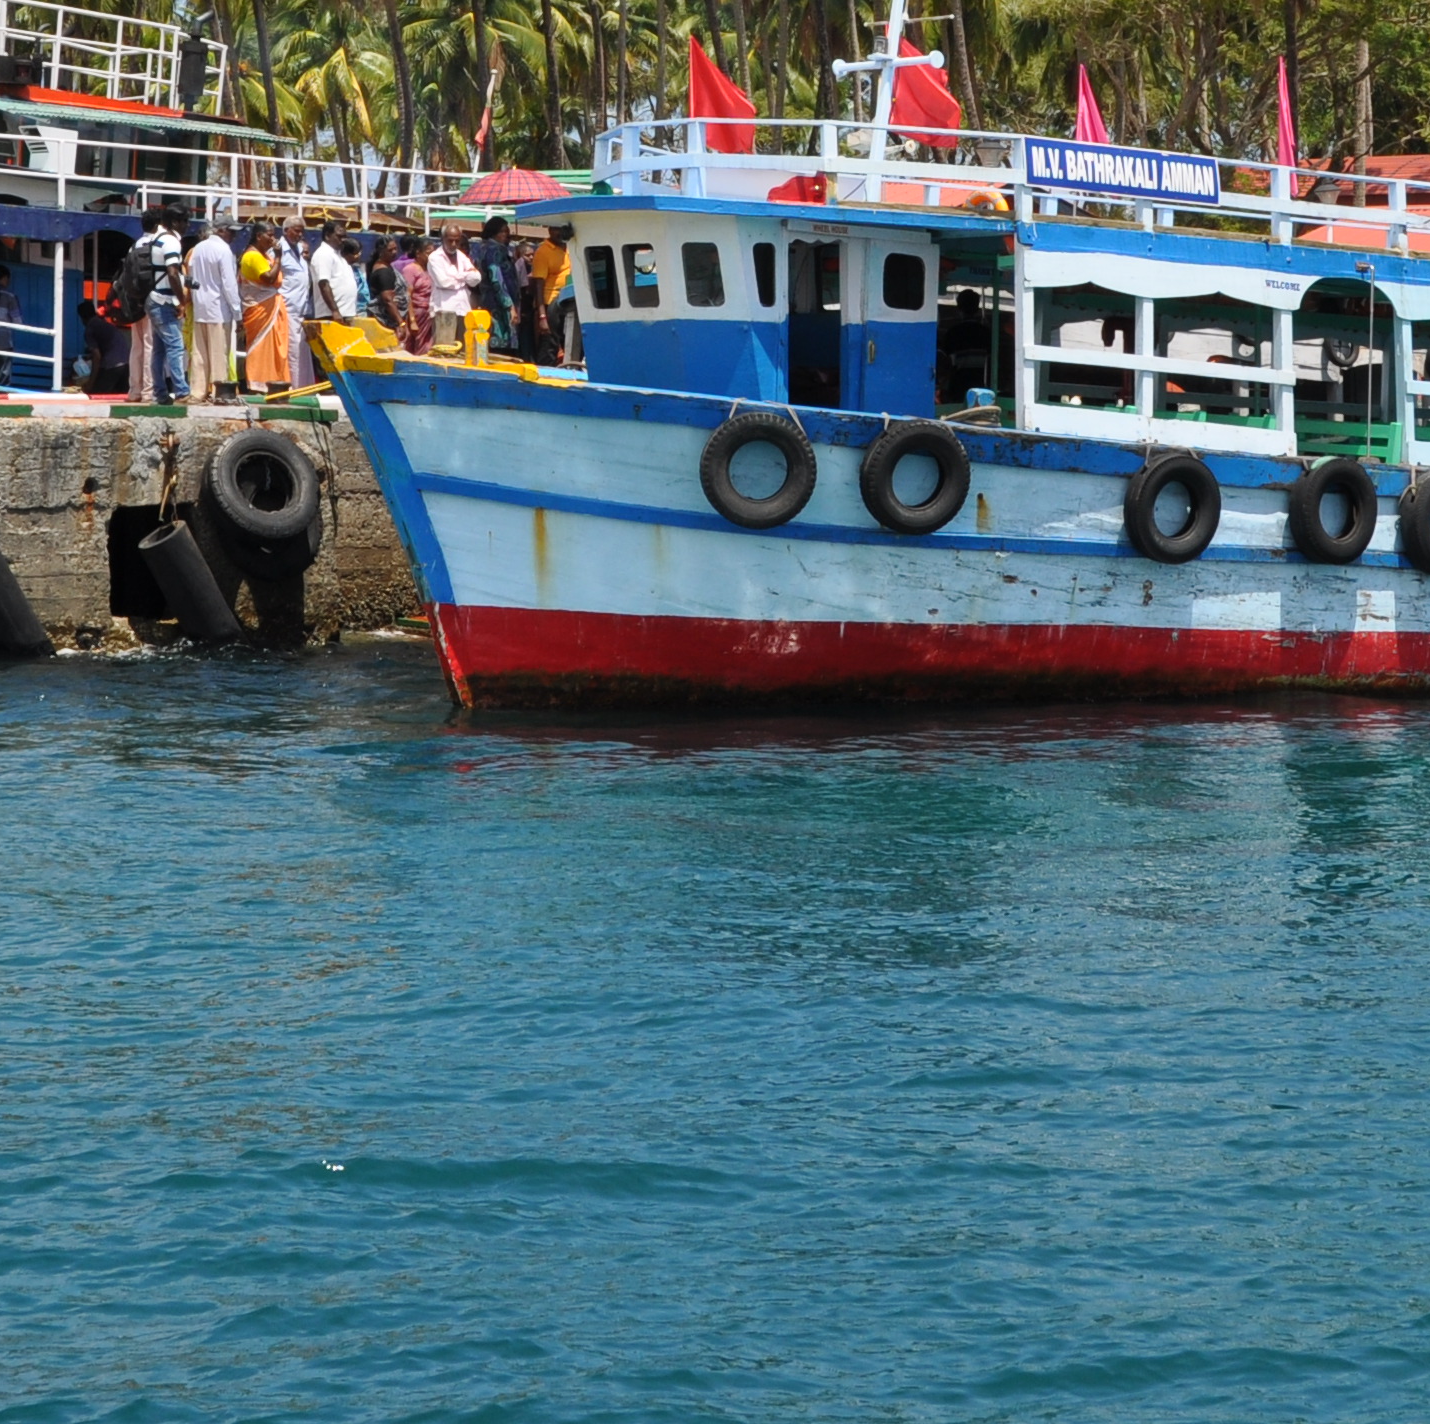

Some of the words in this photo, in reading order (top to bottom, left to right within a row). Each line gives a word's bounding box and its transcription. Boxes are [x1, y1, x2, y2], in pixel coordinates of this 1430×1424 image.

[1031, 146, 1064, 180] M.V.
[1065, 149, 1158, 190] BATHRAKALI
[1161, 160, 1215, 196] AMMAN
[1265, 279, 1300, 291] WELCOME
